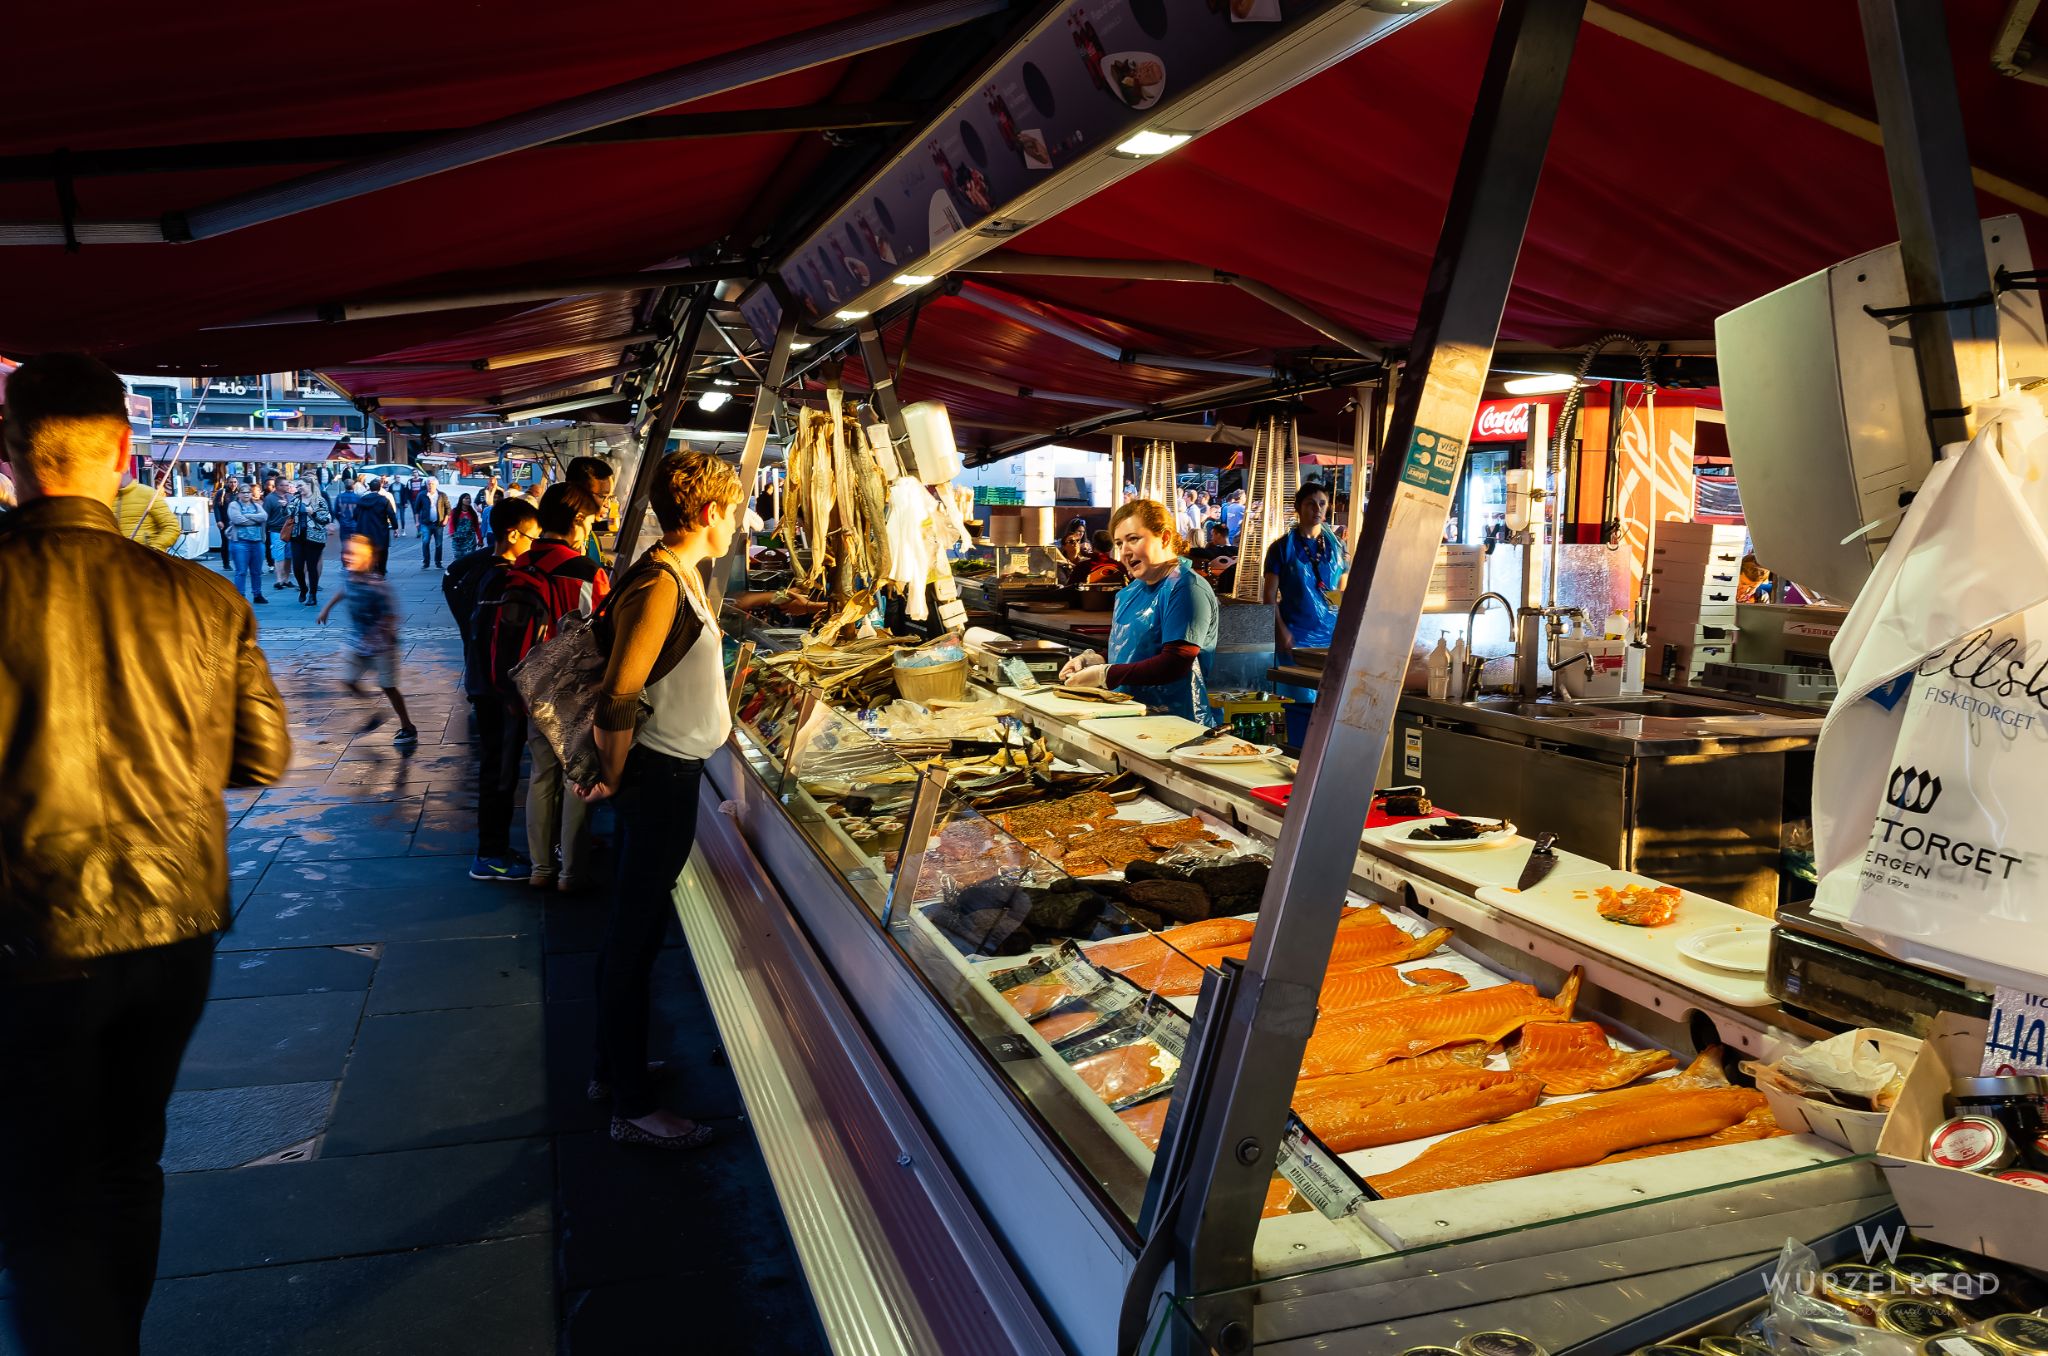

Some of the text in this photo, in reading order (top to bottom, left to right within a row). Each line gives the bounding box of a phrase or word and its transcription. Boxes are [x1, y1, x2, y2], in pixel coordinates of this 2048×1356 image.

[1478, 403, 1530, 436] Coca-Col
[1440, 442, 1458, 453] VISA
[1924, 686, 2036, 731] FISKETORGET
[1869, 817, 2023, 880] TORGET
